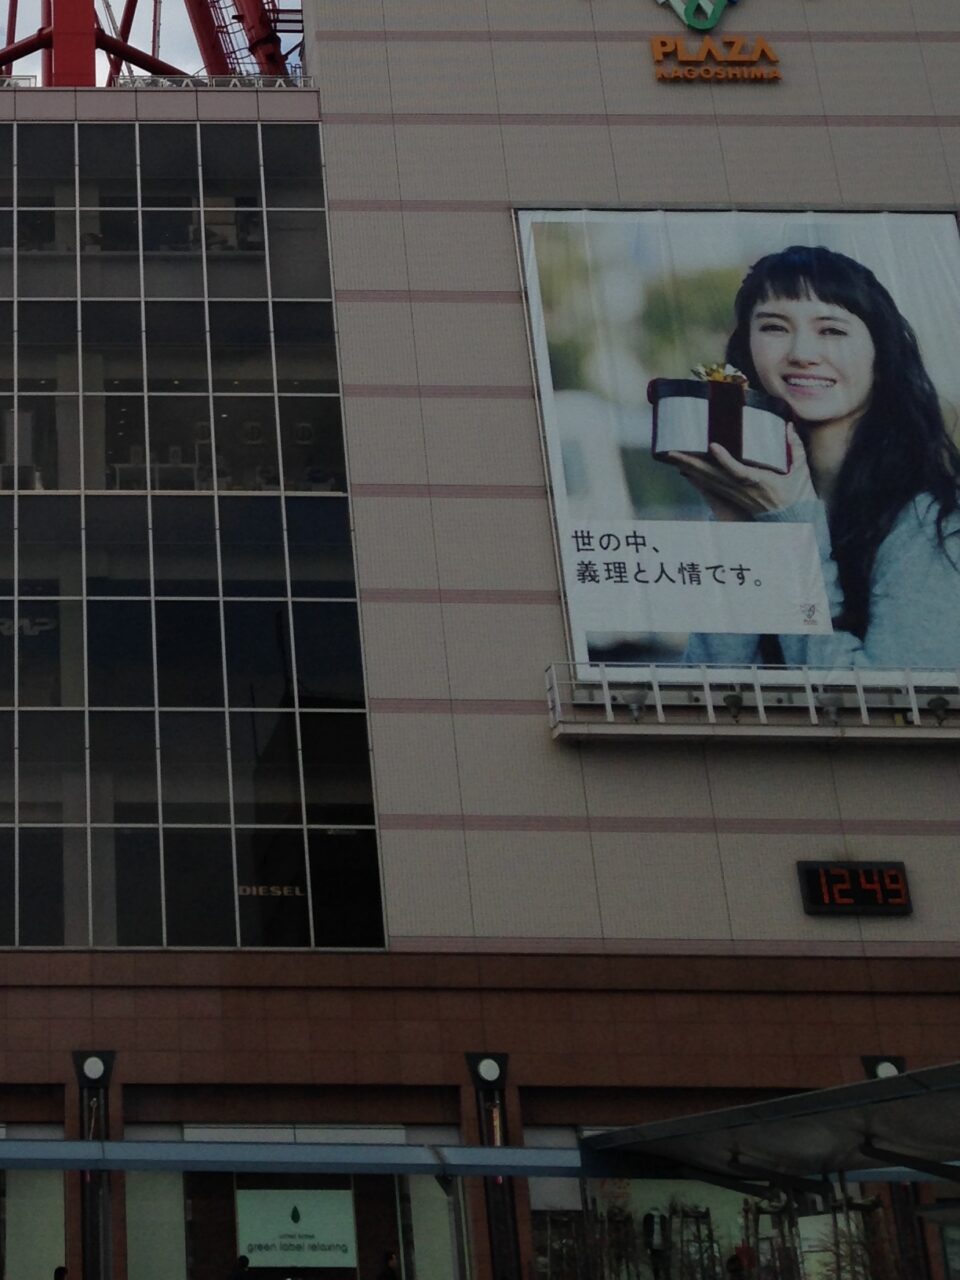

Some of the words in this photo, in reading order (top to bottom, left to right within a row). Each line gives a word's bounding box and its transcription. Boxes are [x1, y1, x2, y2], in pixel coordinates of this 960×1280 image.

[651, 35, 779, 63] PLAZA
[656, 66, 781, 81] KAGOSHIMA
[571, 530, 660, 554] 世の中、
[576, 560, 763, 587] 義理と人情です。
[238, 884, 305, 897] DIESEL
[247, 1243, 277, 1253] green
[279, 1242, 305, 1252] label
[307, 1242, 349, 1253] relaxing
